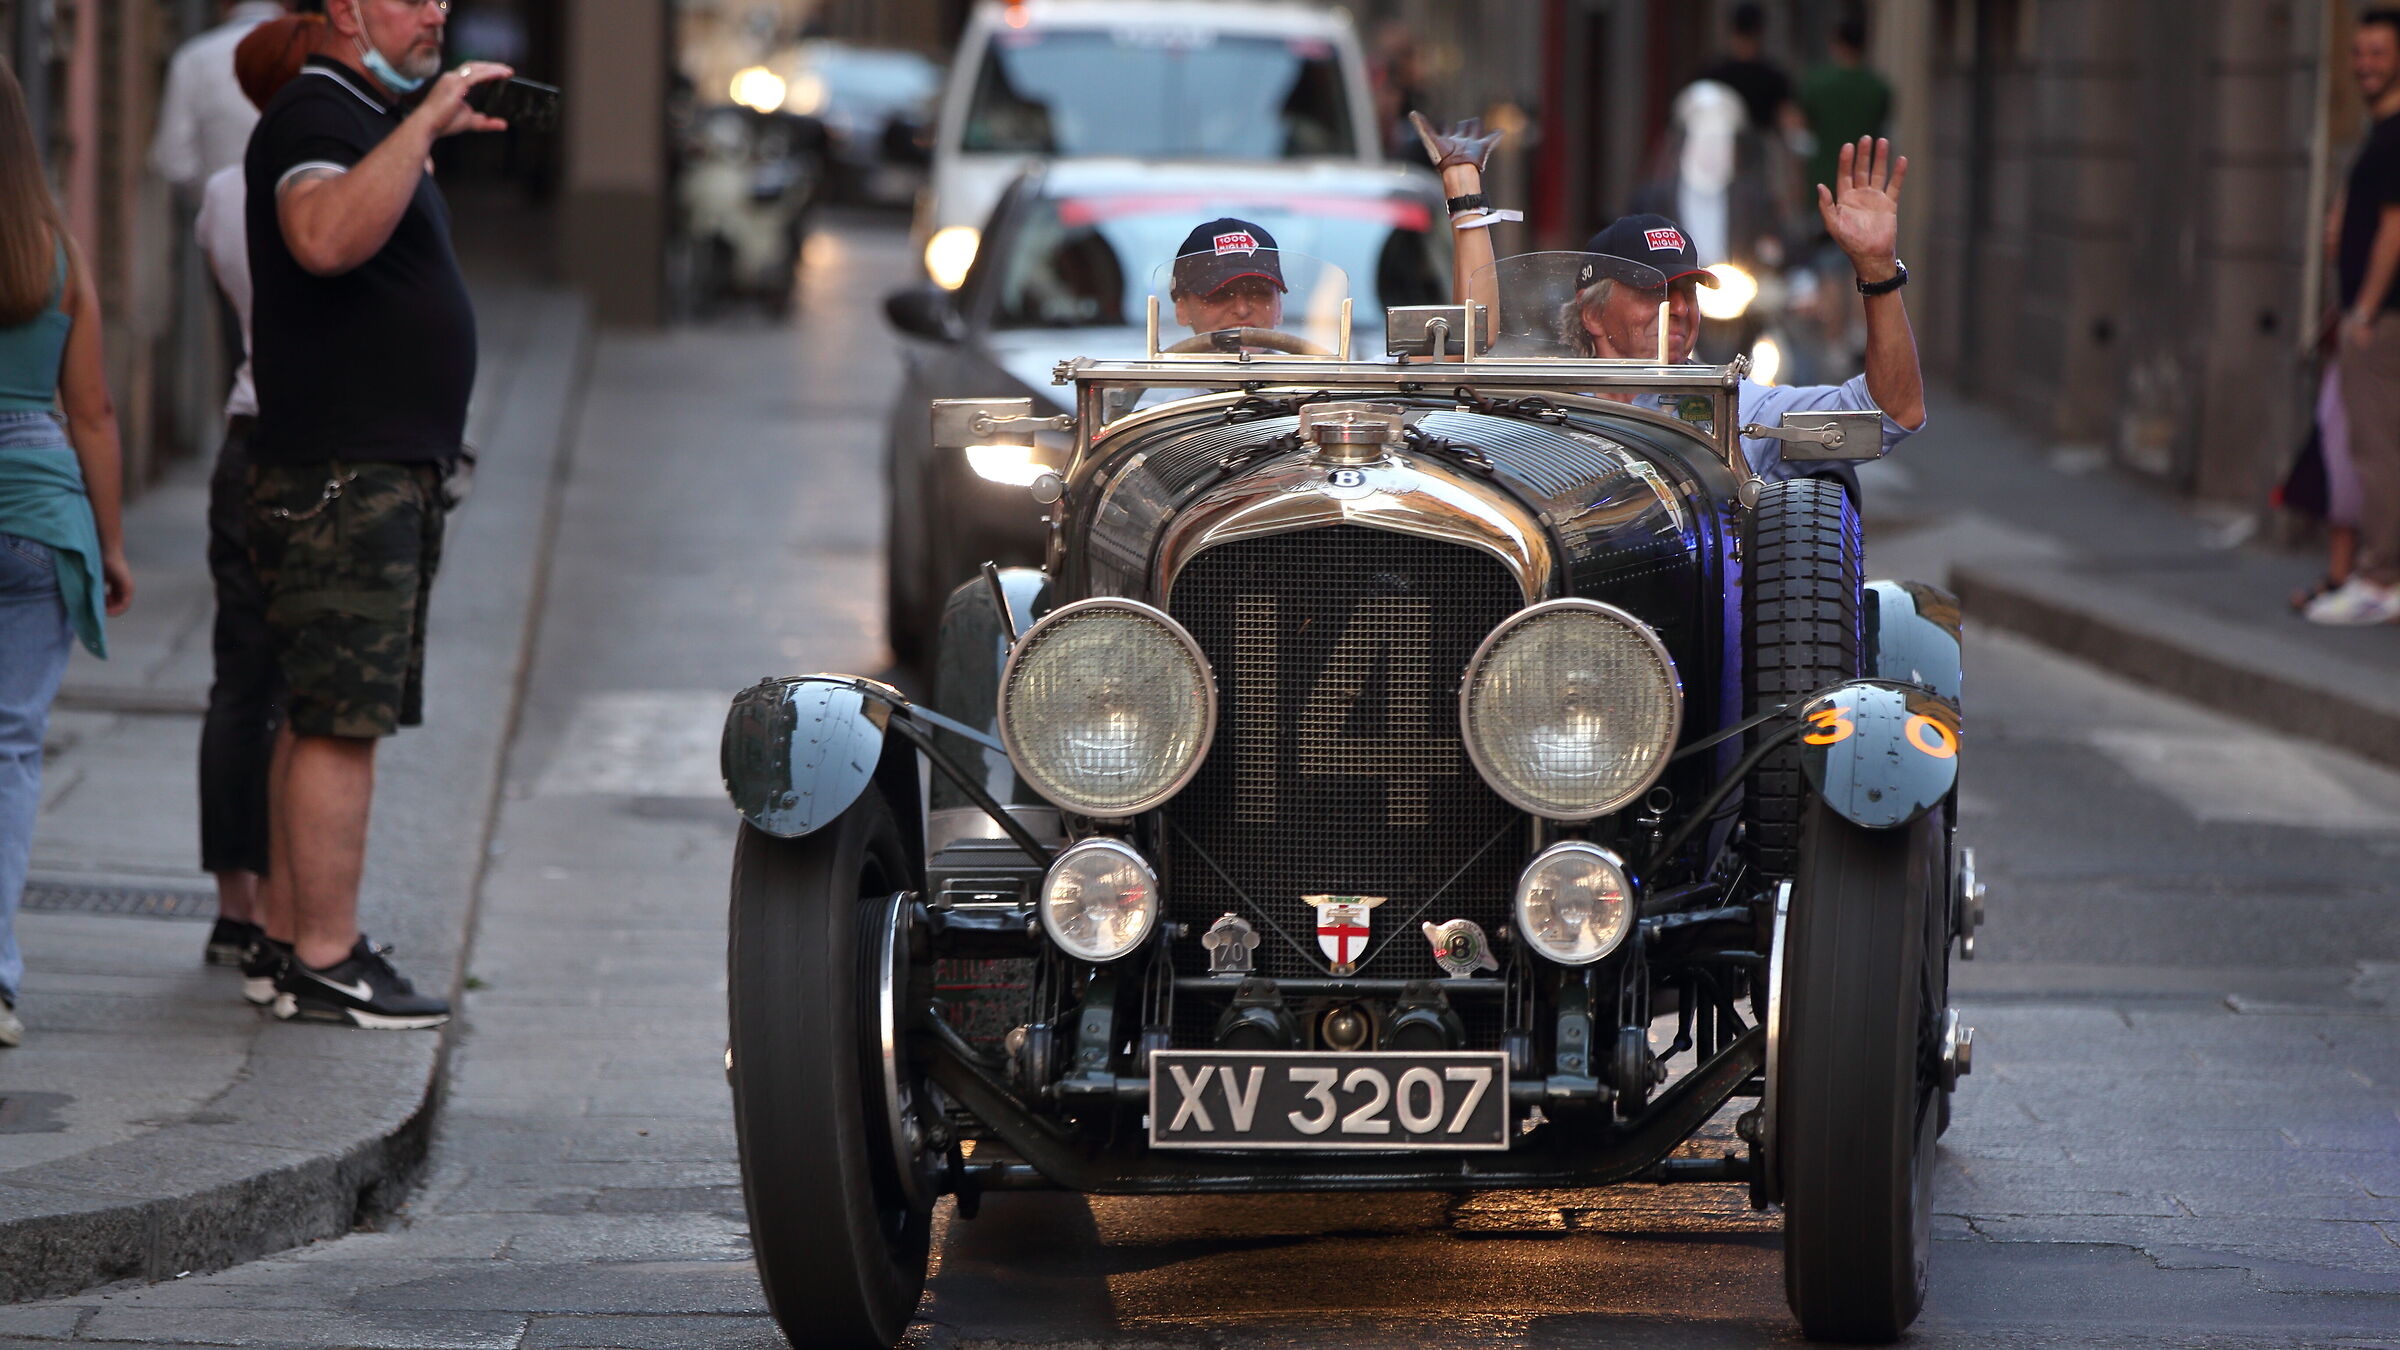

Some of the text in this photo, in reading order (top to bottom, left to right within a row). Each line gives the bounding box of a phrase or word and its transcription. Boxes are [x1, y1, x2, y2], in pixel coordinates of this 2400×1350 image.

[1221, 235, 1247, 243] 1000
[1650, 231, 1676, 239] 1000
[1652, 239, 1680, 247] MIGLIA
[1581, 264, 1593, 281] 30
[1334, 469, 1361, 487] B
[1234, 594, 1461, 825] 14
[1220, 942, 1244, 962] 70
[1168, 1065, 1493, 1135] XV 3207
